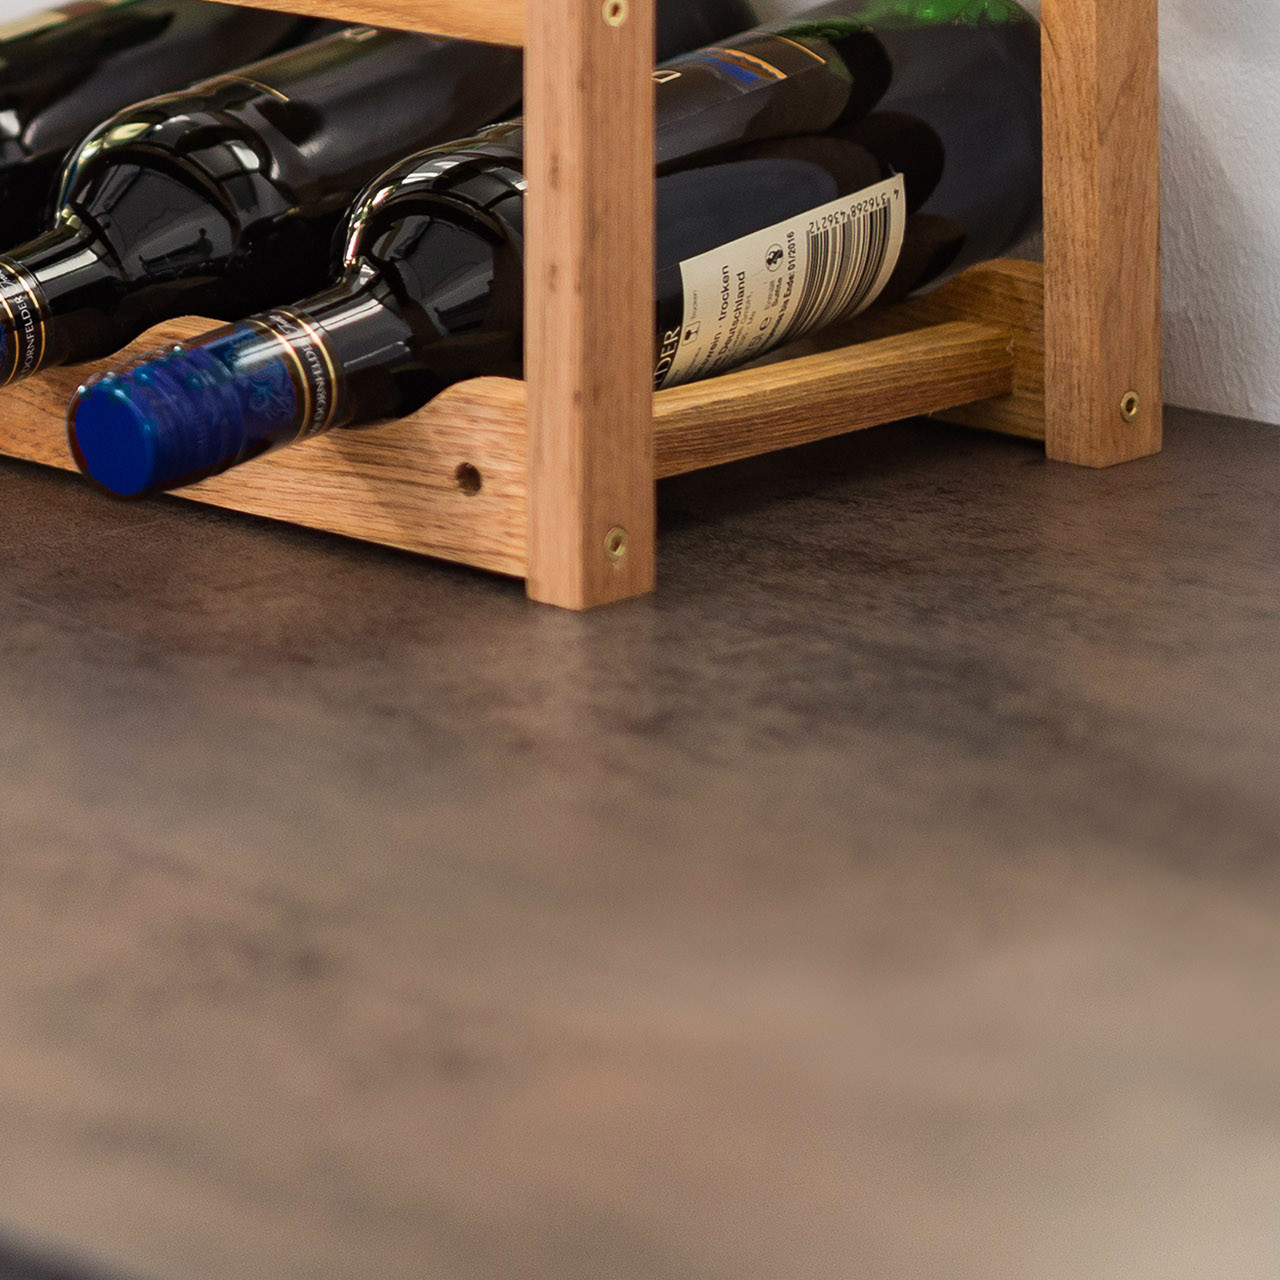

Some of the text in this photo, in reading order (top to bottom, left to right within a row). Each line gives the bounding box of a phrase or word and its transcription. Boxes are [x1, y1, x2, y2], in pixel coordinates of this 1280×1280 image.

[786, 230, 796, 271] 01/2016
[718, 264, 730, 321] trocken
[719, 270, 746, 356] Deutschland
[15, 294, 36, 375] DORNFELDER
